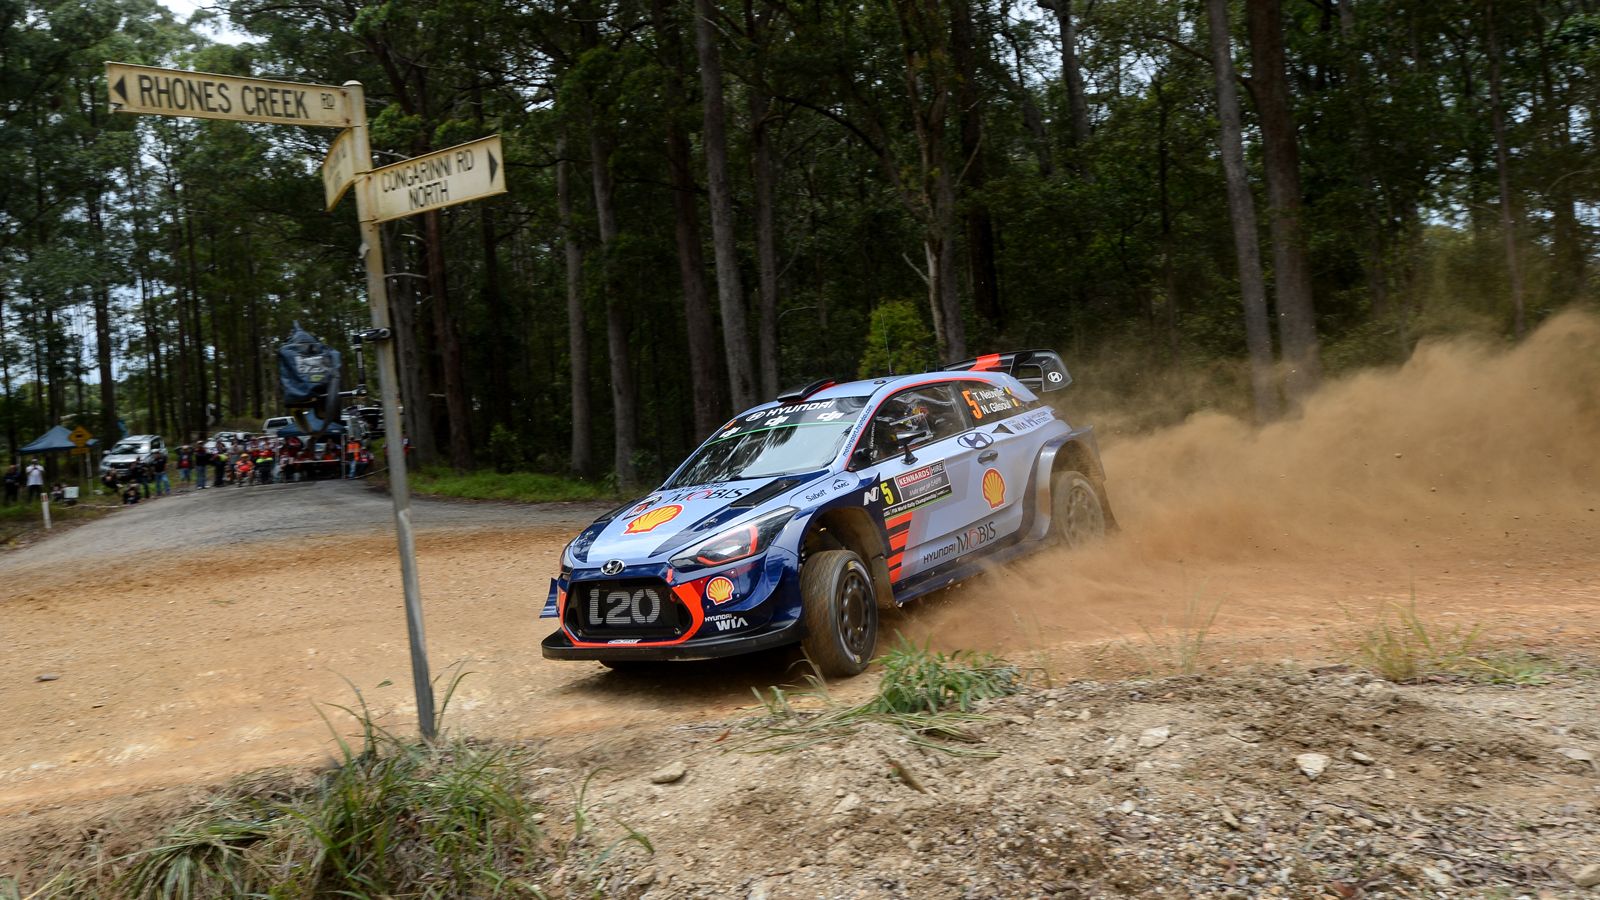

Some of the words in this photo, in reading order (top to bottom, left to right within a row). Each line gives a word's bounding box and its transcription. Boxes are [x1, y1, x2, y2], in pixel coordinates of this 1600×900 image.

[138, 74, 232, 114] RHONES
[241, 85, 309, 119] CREEK
[320, 92, 336, 106] RD
[381, 154, 452, 193] CONGARINNI
[455, 148, 475, 174] RD
[408, 180, 450, 211] NORTH
[765, 401, 836, 417] HYUNDAI
[962, 388, 983, 419] 5
[898, 468, 930, 486] KENNARDS
[664, 487, 750, 503] MOBIS
[805, 488, 828, 502] Sabelt
[880, 482, 894, 505] 5
[923, 543, 956, 565] HYUNDAI
[956, 521, 997, 554] MOBIS
[704, 613, 733, 623] HYUNDAI
